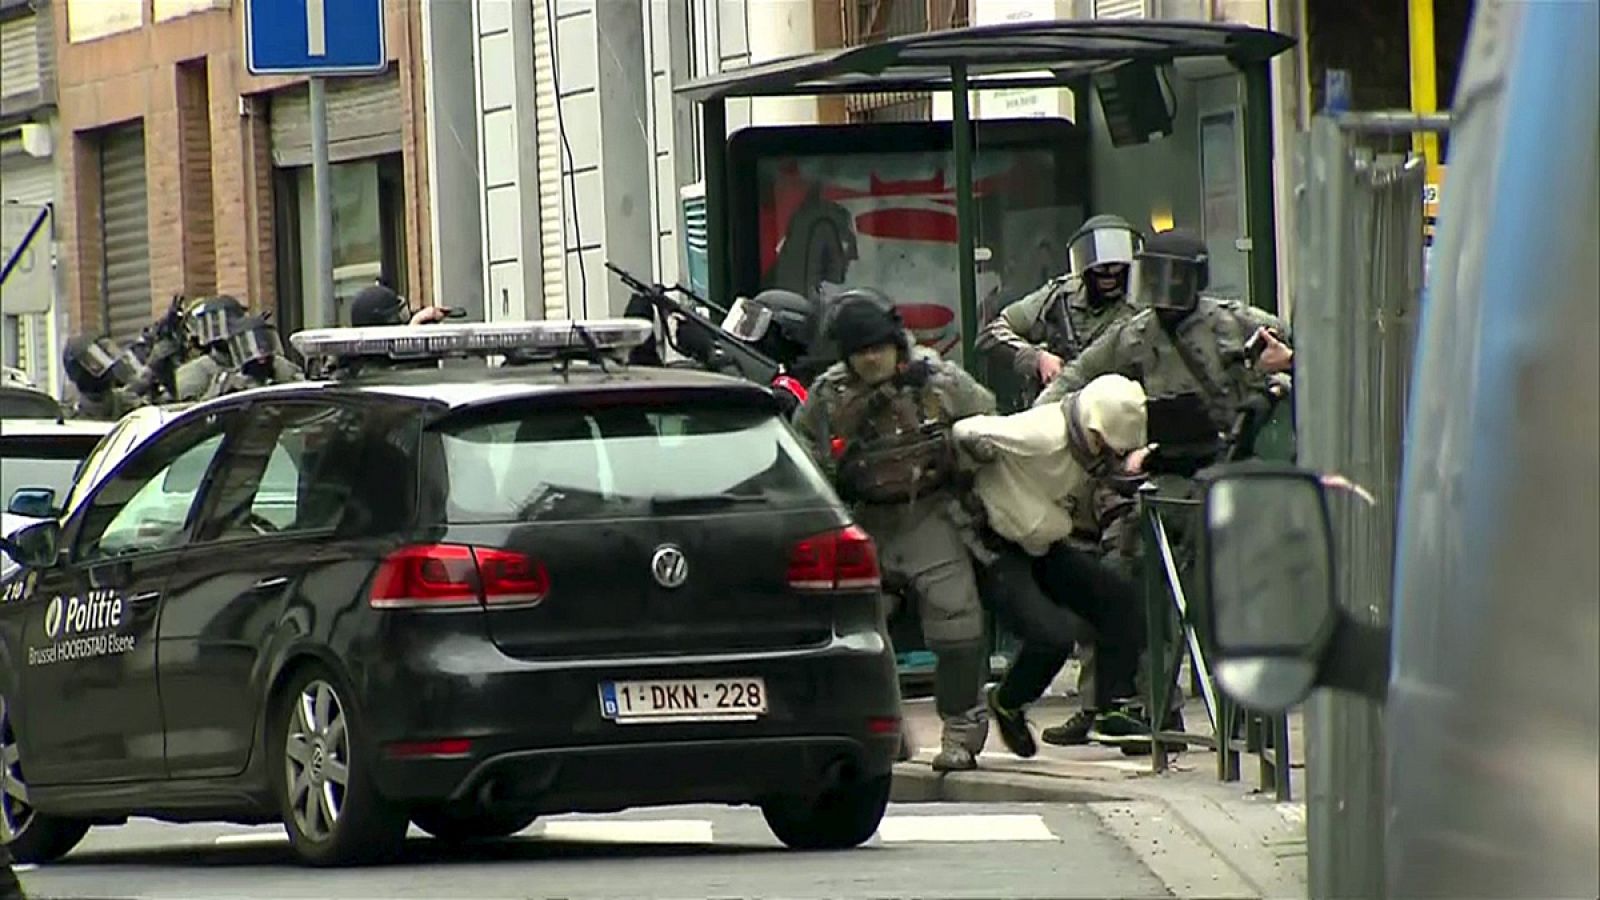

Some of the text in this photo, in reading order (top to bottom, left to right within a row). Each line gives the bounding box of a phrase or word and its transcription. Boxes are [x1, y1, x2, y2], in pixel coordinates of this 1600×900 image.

[64, 589, 122, 633] Politie
[28, 632, 135, 665] Brussel HOOFDSTAD Elsene
